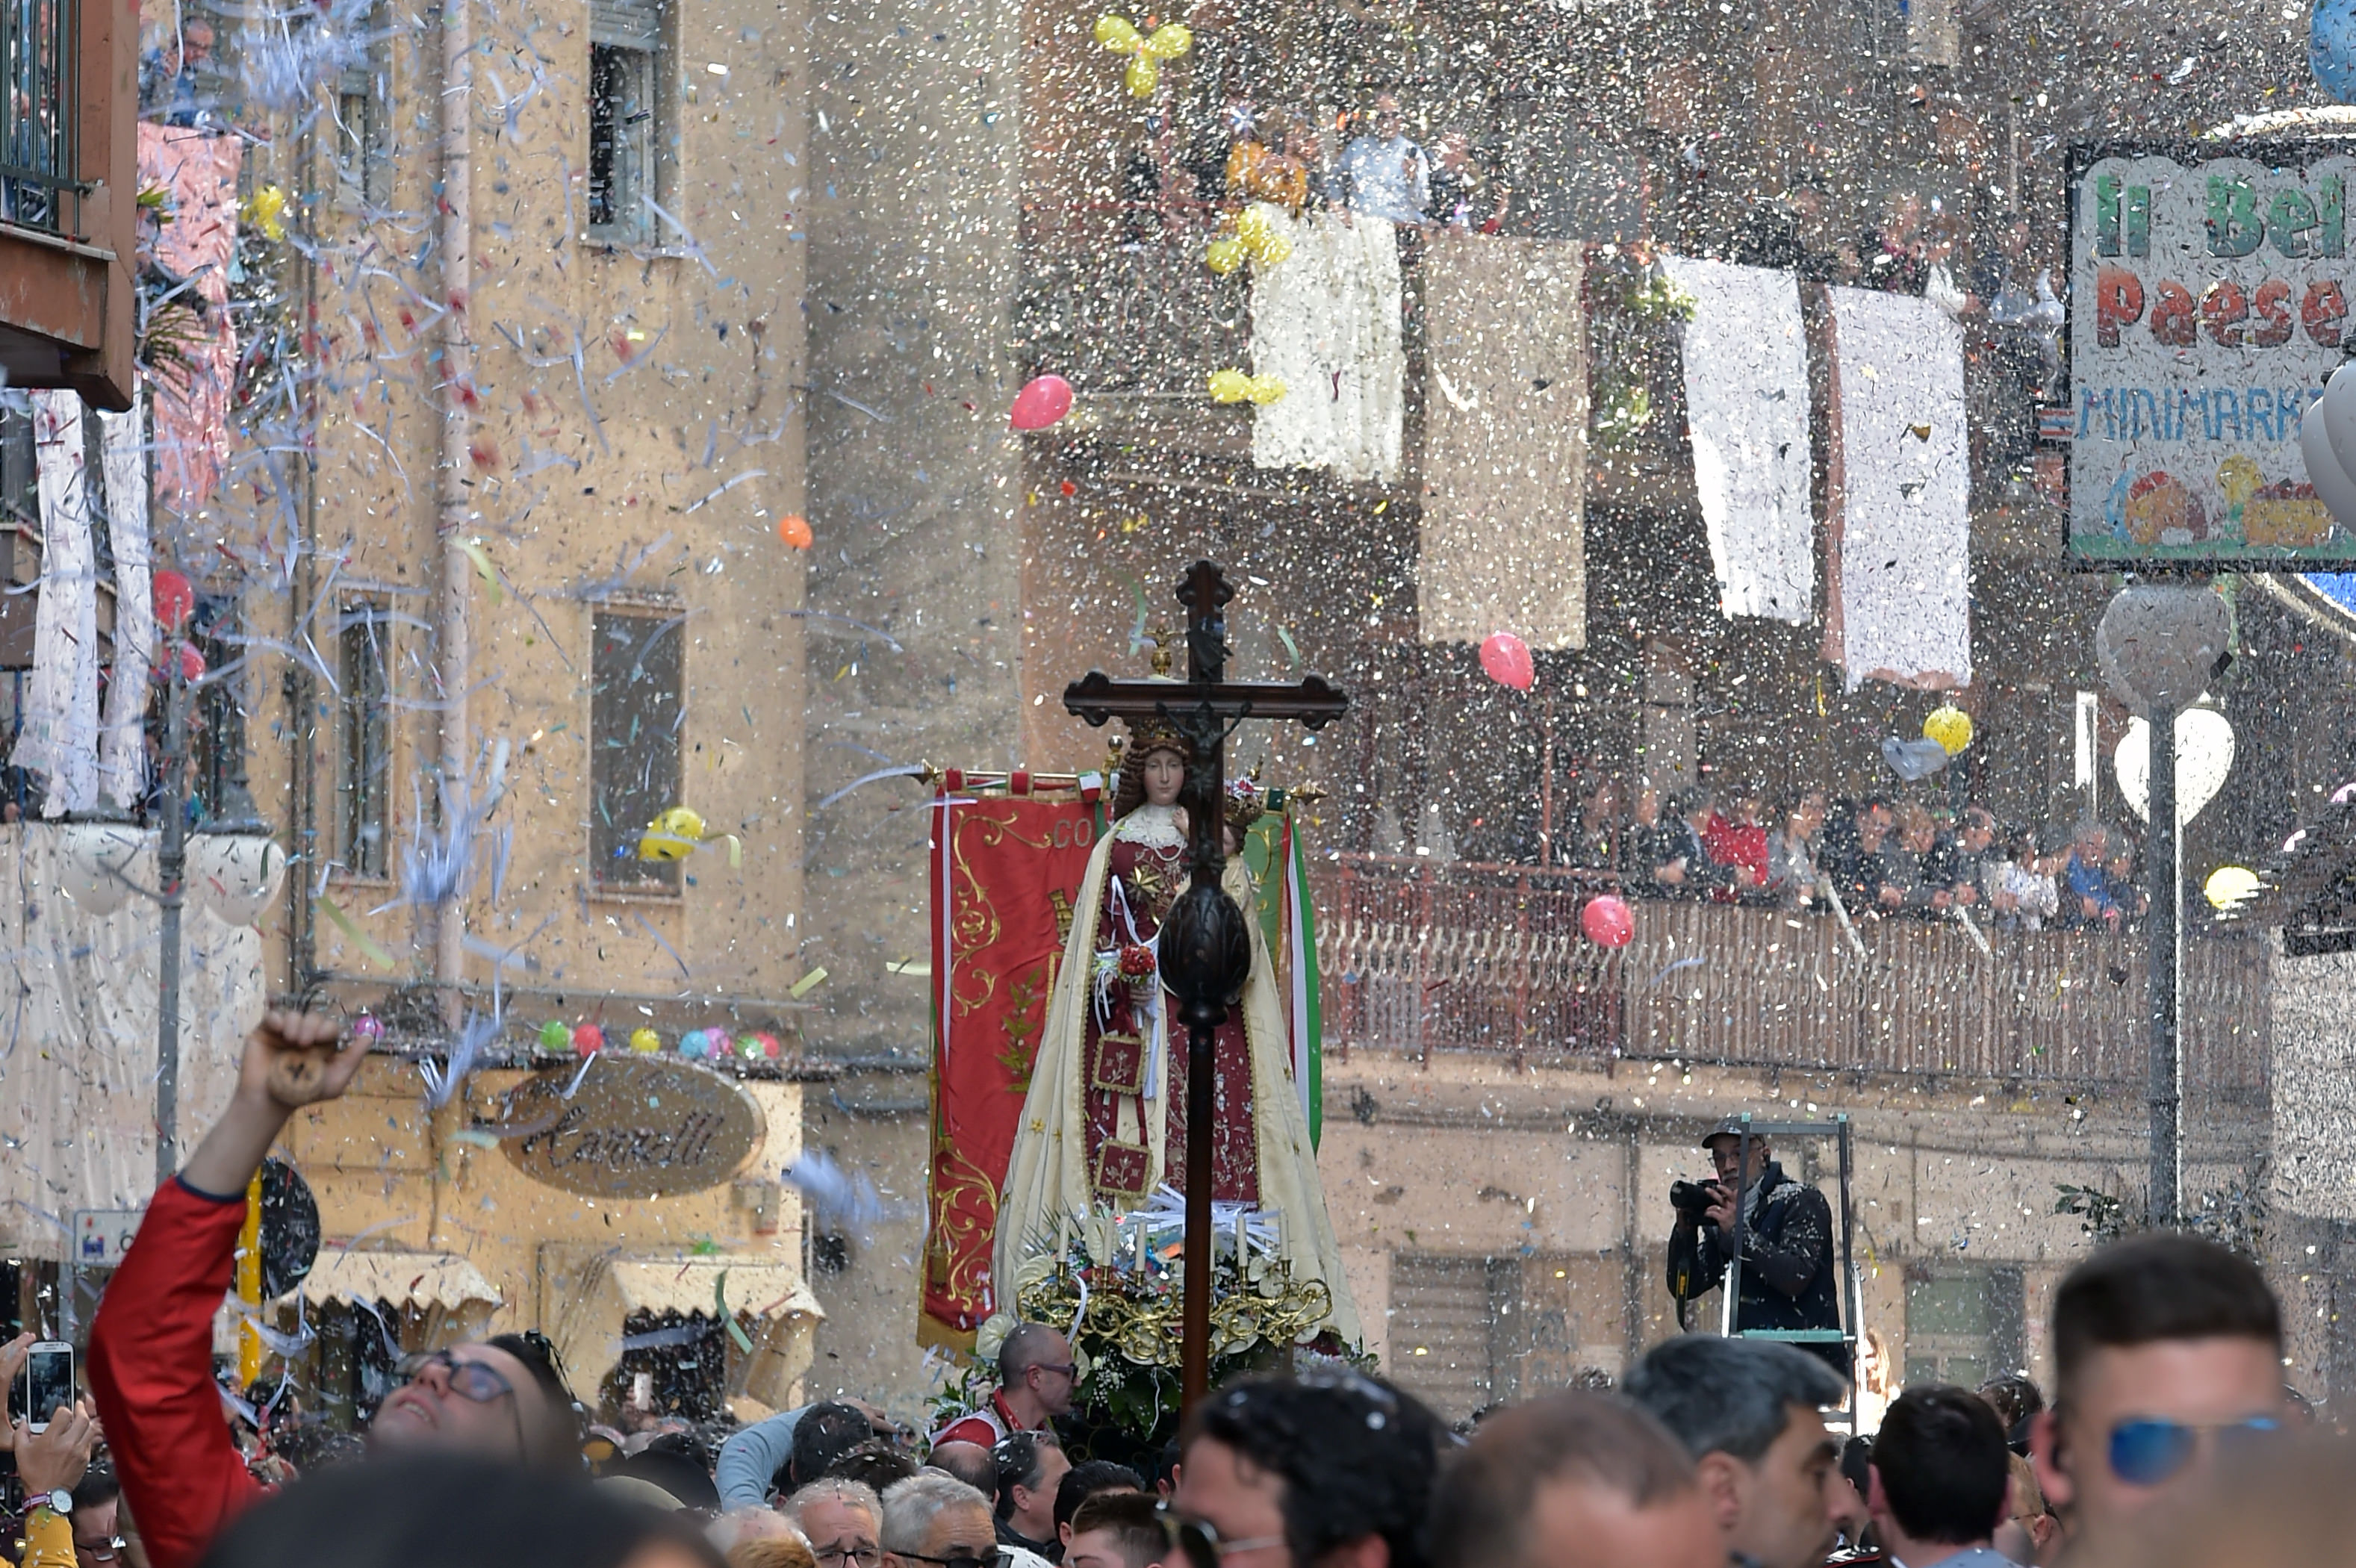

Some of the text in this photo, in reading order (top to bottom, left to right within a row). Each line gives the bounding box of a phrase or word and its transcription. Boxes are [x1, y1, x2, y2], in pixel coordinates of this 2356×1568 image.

[2097, 174, 2346, 258] Il Bel
[2097, 264, 2349, 349] Paese
[2078, 387, 2324, 441] MINIMARK
